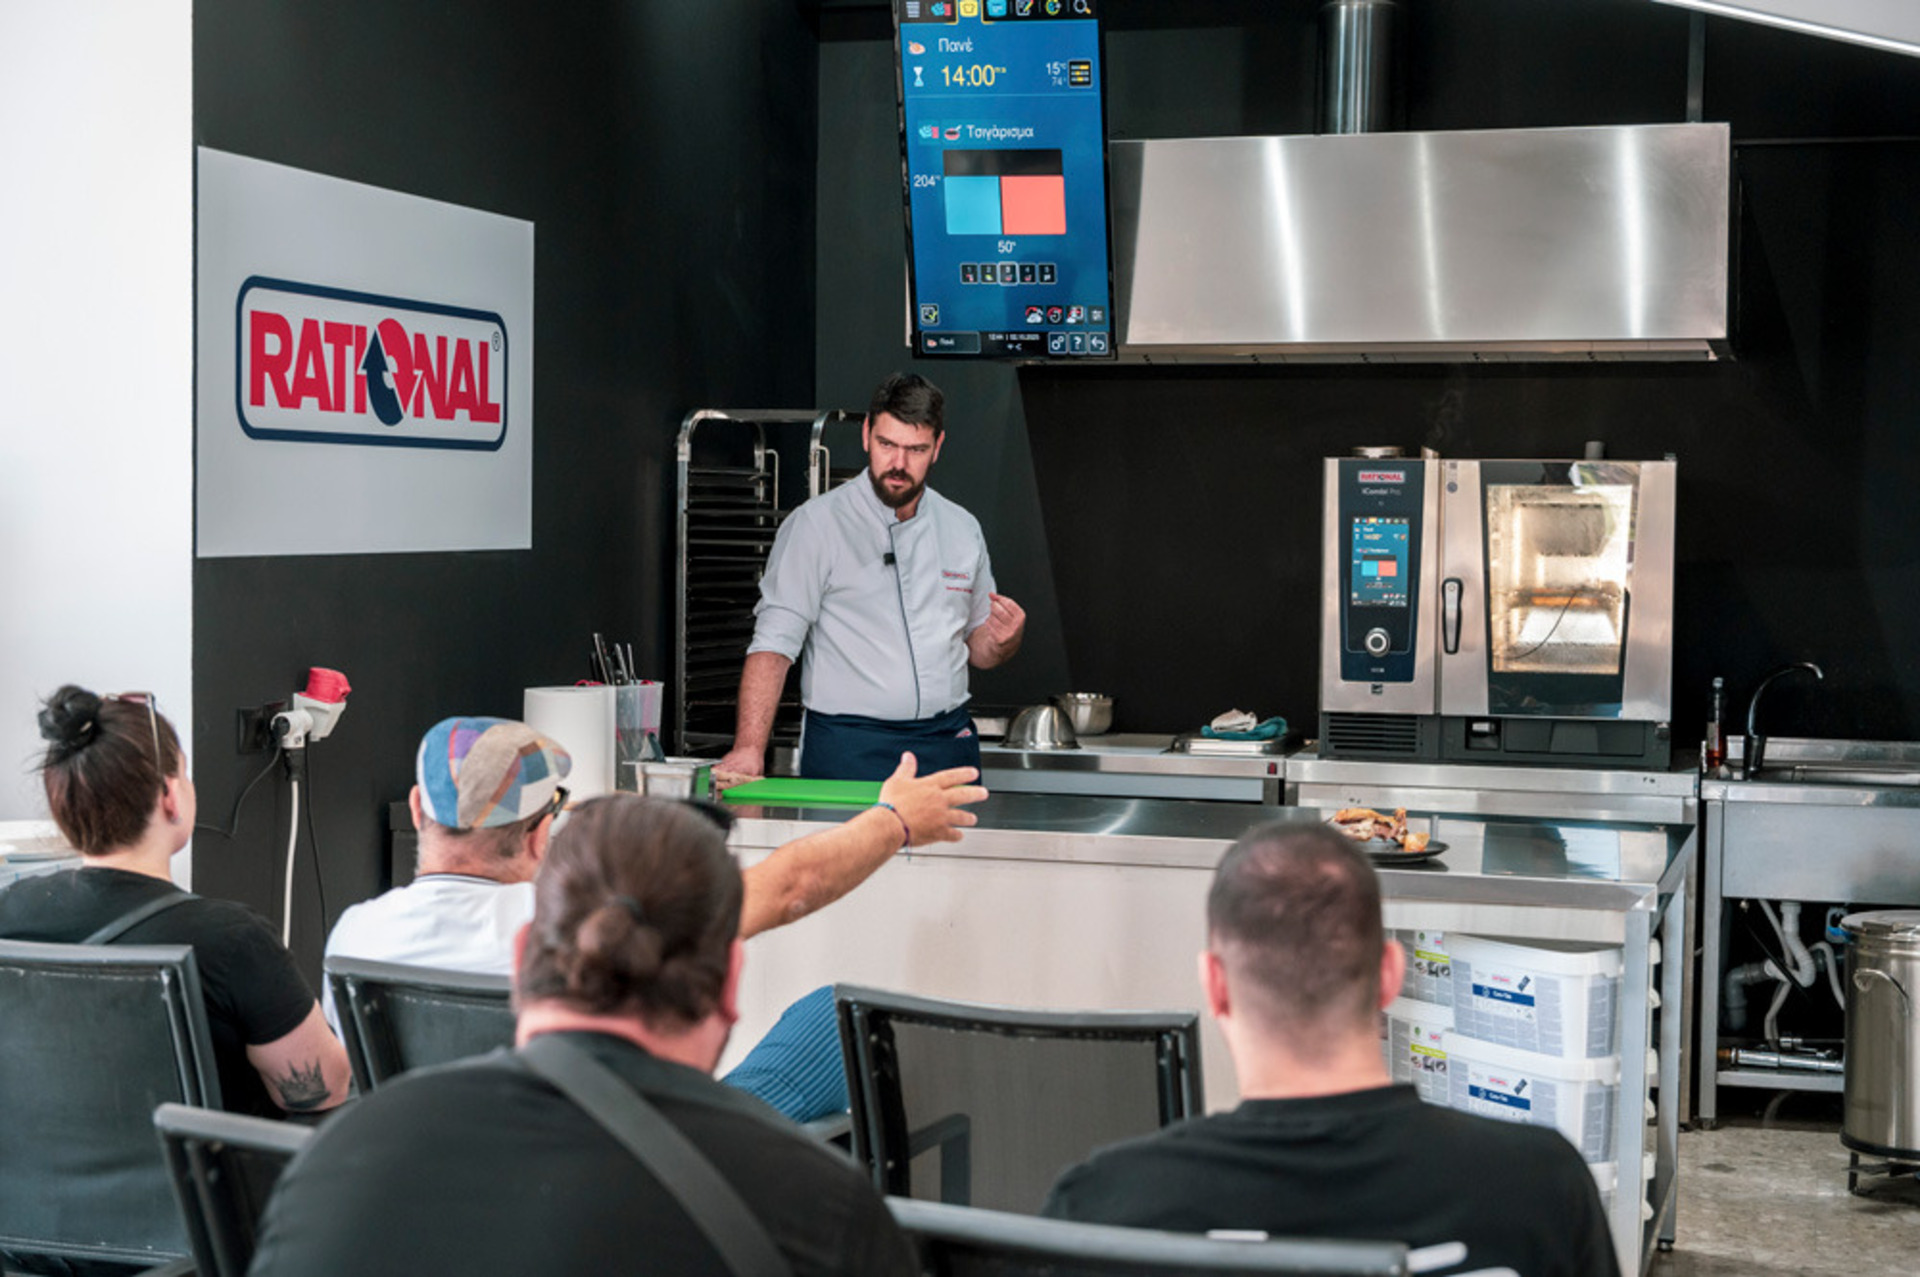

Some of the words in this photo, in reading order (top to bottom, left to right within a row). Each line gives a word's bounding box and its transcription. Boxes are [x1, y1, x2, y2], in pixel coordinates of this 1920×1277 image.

[938, 37, 973, 53] Πανέ
[966, 124, 1034, 140] Τσιγάρισμα
[249, 309, 501, 427] RATIONAL
